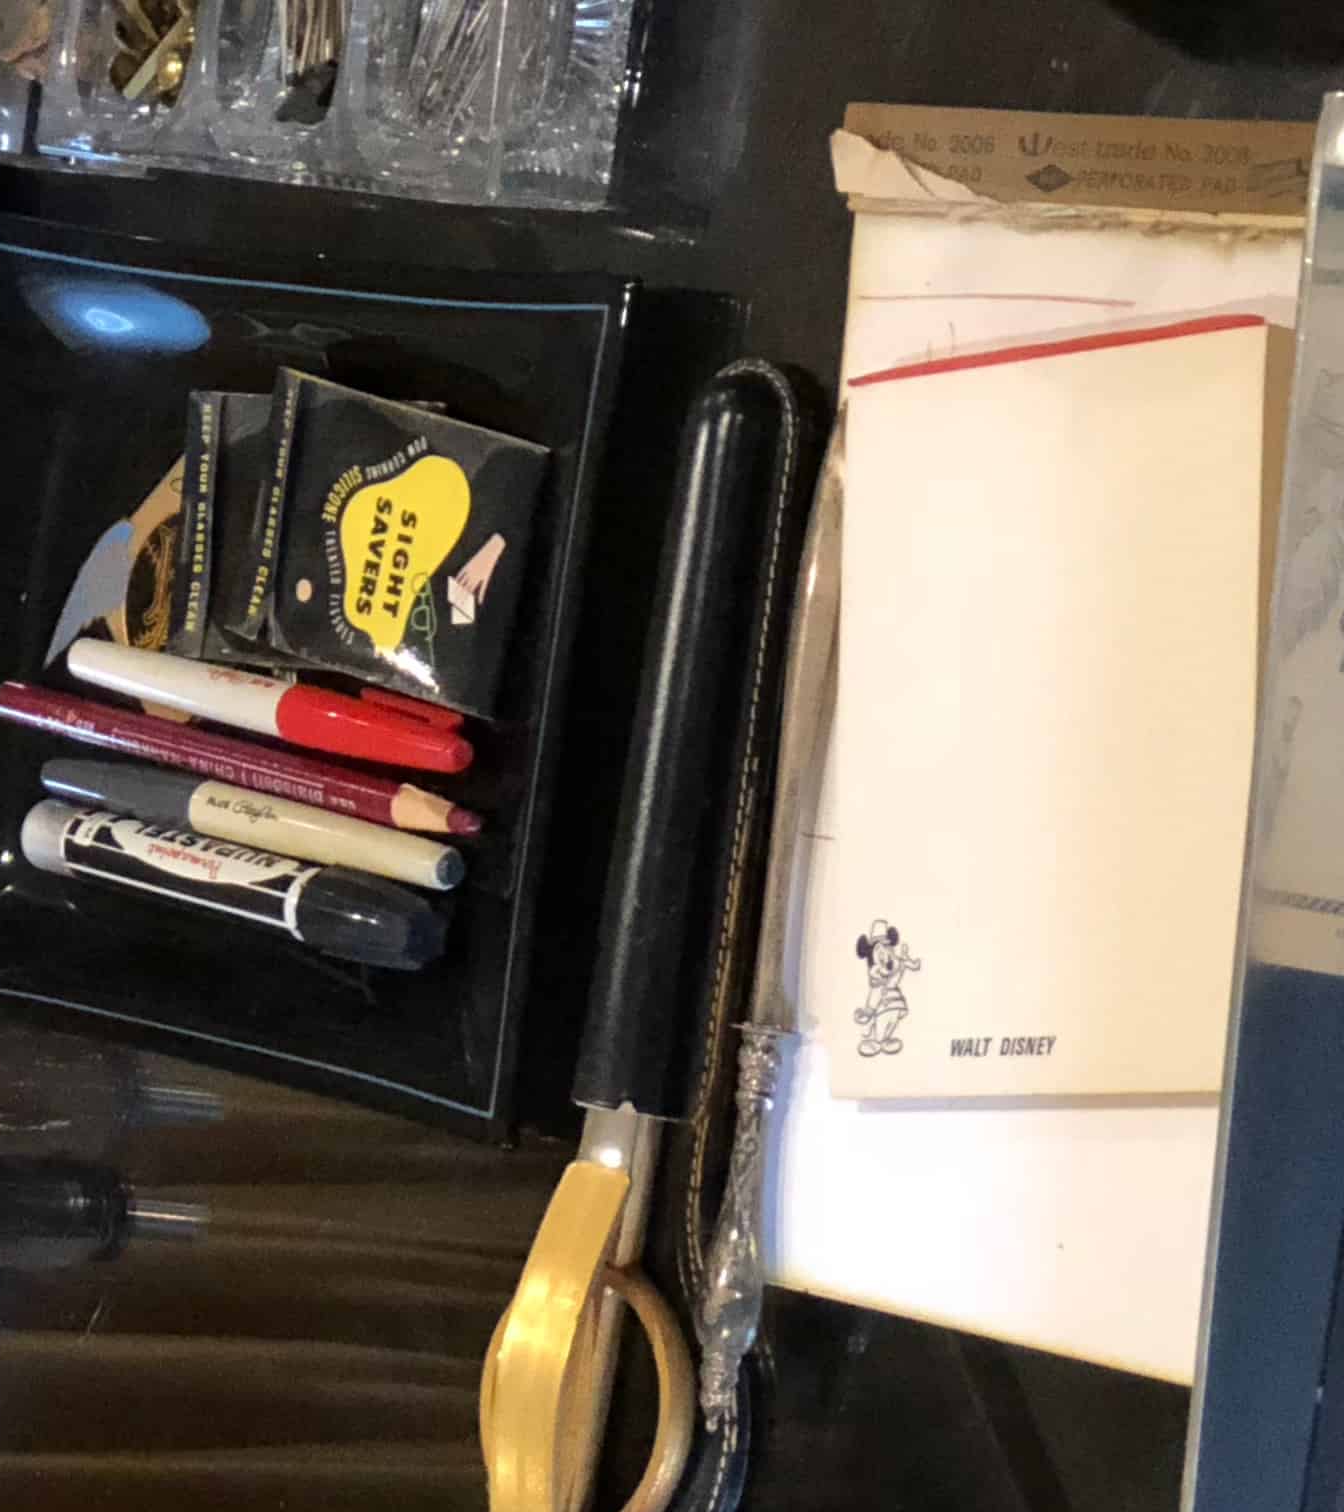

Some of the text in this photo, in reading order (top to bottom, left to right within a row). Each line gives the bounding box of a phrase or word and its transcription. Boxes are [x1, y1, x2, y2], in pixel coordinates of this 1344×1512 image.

[1077, 168, 1192, 194] PERFORATED
[320, 465, 362, 524] SILICONE
[356, 496, 393, 617] SAVERS
[382, 509, 418, 619] SIGHT
[949, 1035, 1057, 1057] WALT DISNEY
